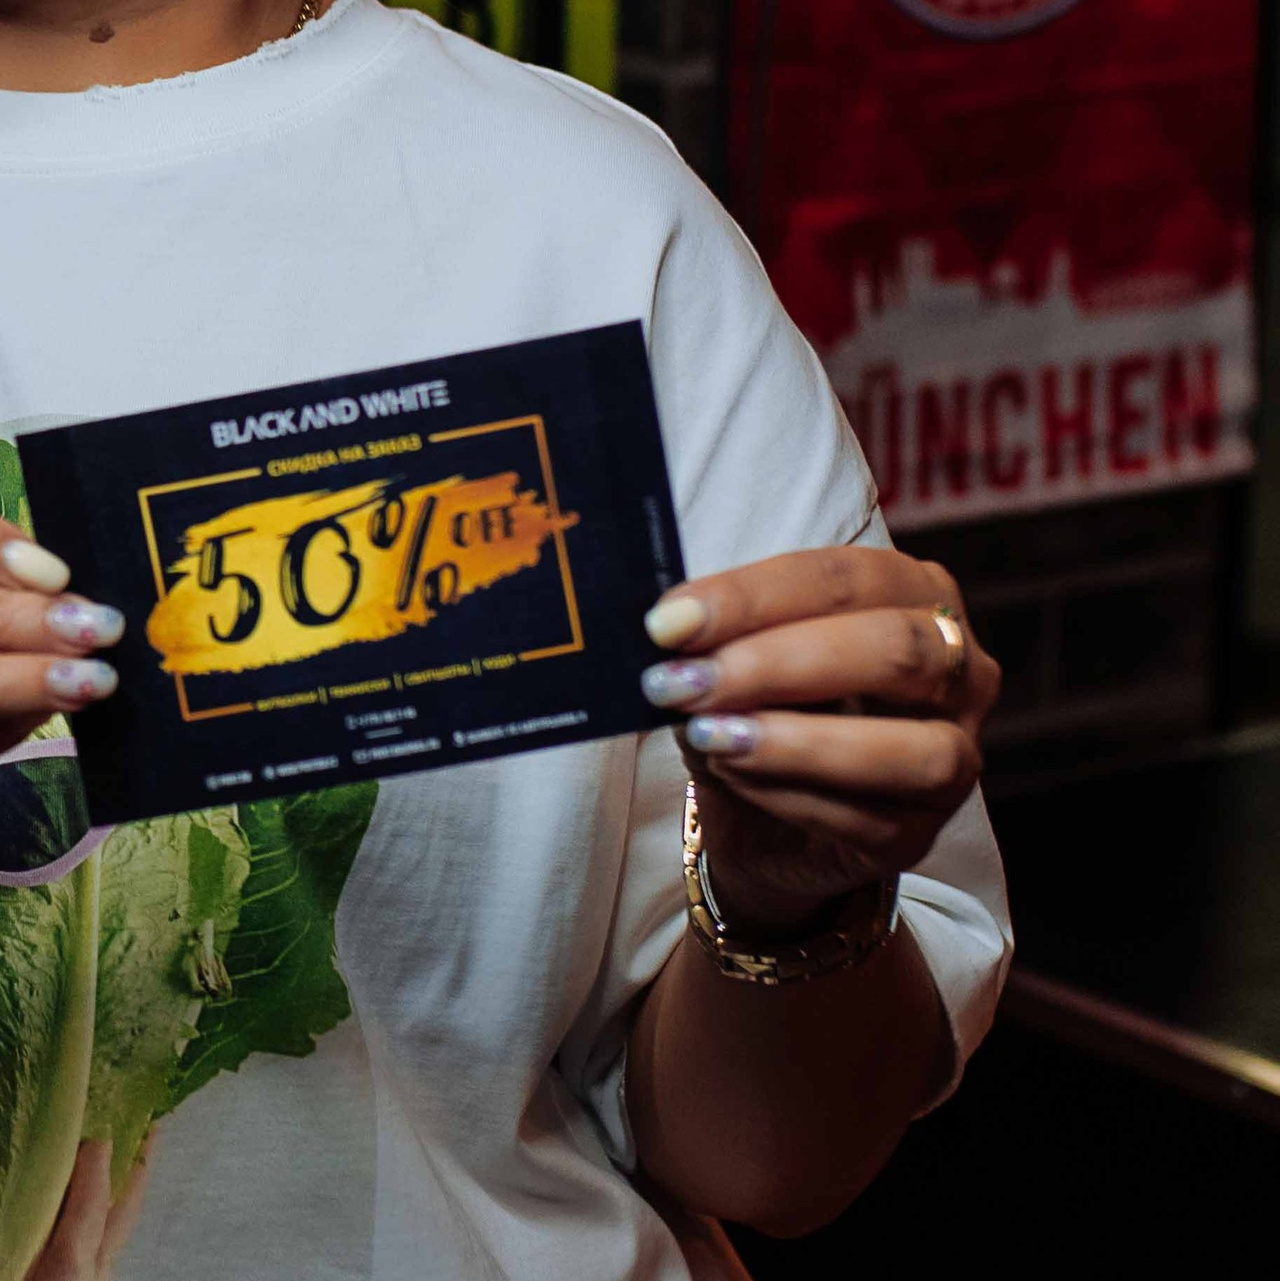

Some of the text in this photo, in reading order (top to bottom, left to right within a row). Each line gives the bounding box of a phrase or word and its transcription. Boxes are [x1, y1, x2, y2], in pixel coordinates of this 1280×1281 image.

[210, 379, 451, 448] BLACK AND WHITE
[842, 342, 1221, 510] ÜNCHEN
[198, 494, 459, 645] 50%
